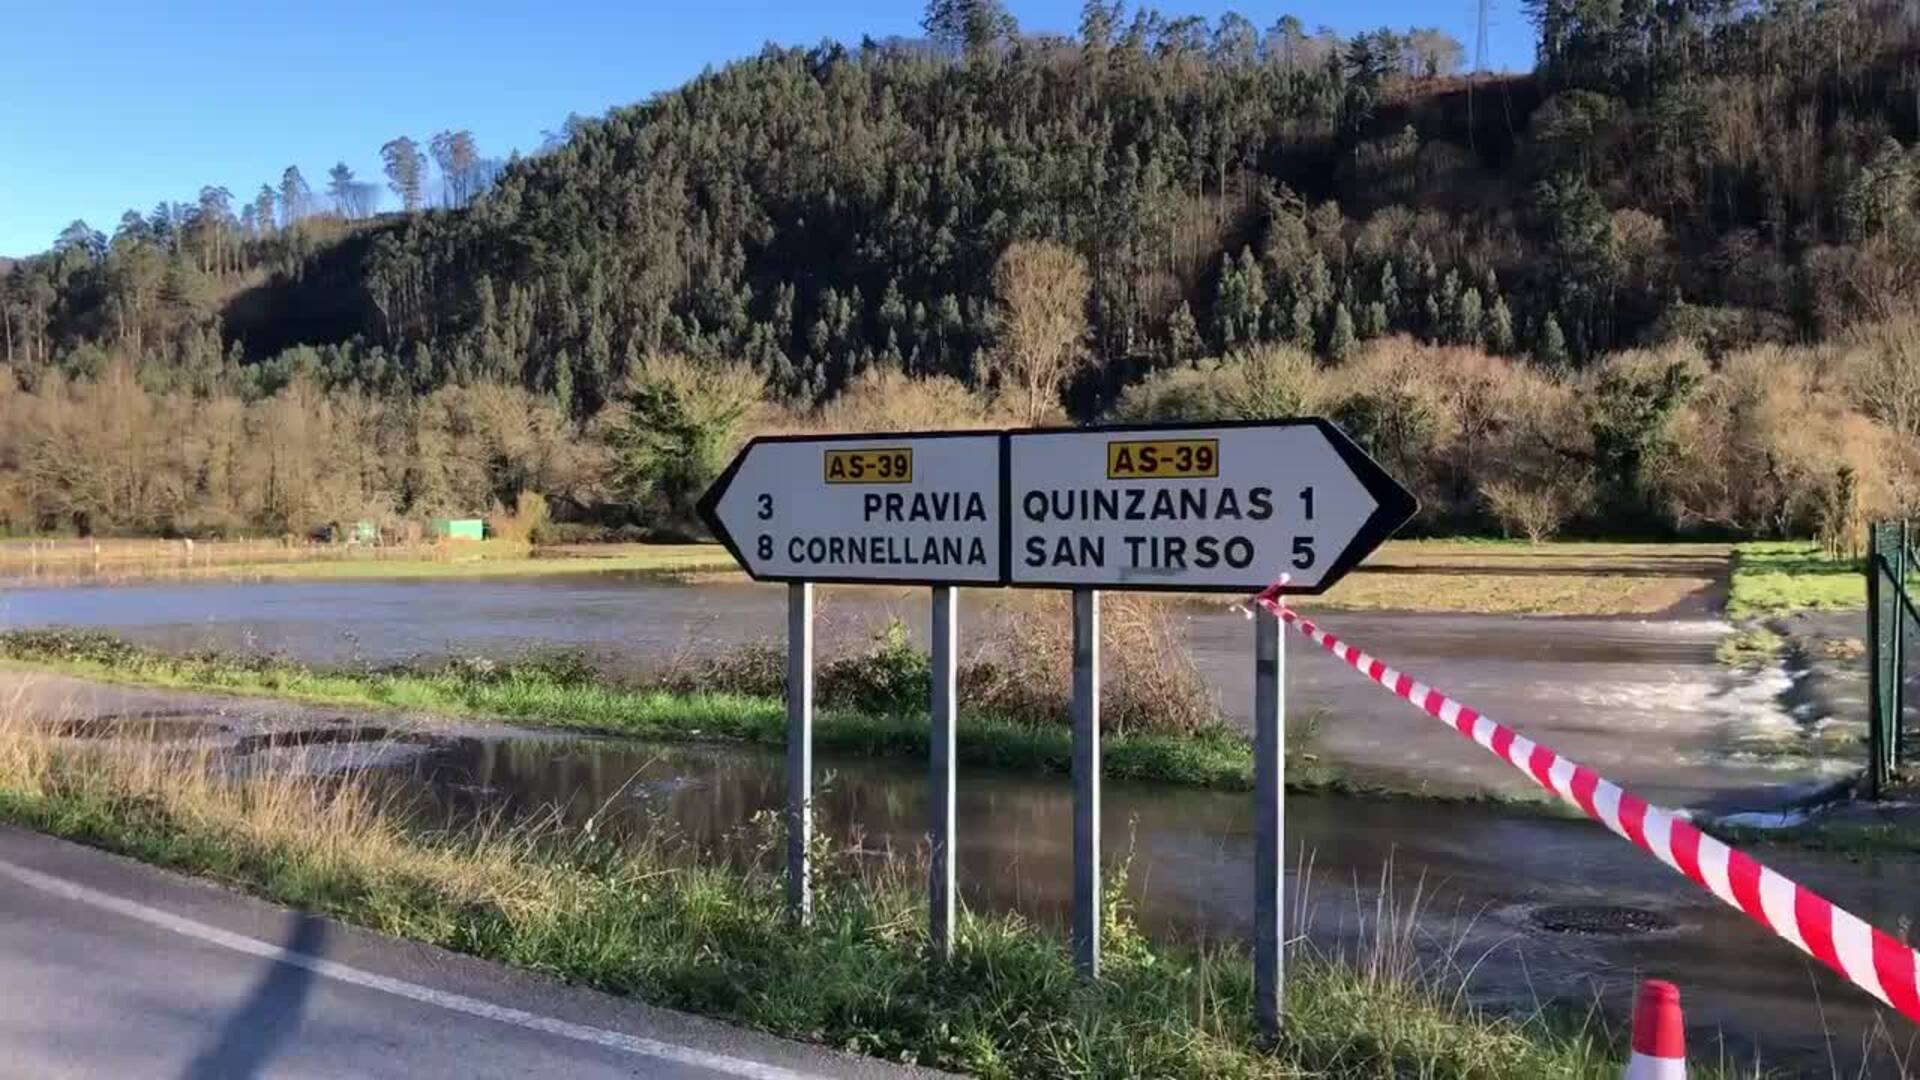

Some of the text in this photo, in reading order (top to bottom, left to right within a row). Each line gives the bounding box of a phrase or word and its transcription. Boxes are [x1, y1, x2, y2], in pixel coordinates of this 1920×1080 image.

[828, 455, 909, 478] AS-39
[1113, 446, 1214, 473] AS-39
[757, 492, 987, 522] 3 PRAVIA
[1023, 486, 1314, 523] QUINZANAS 1
[757, 534, 987, 565] 8 CORNELLANA
[1024, 536, 1316, 570] SAN TIRSO 5
